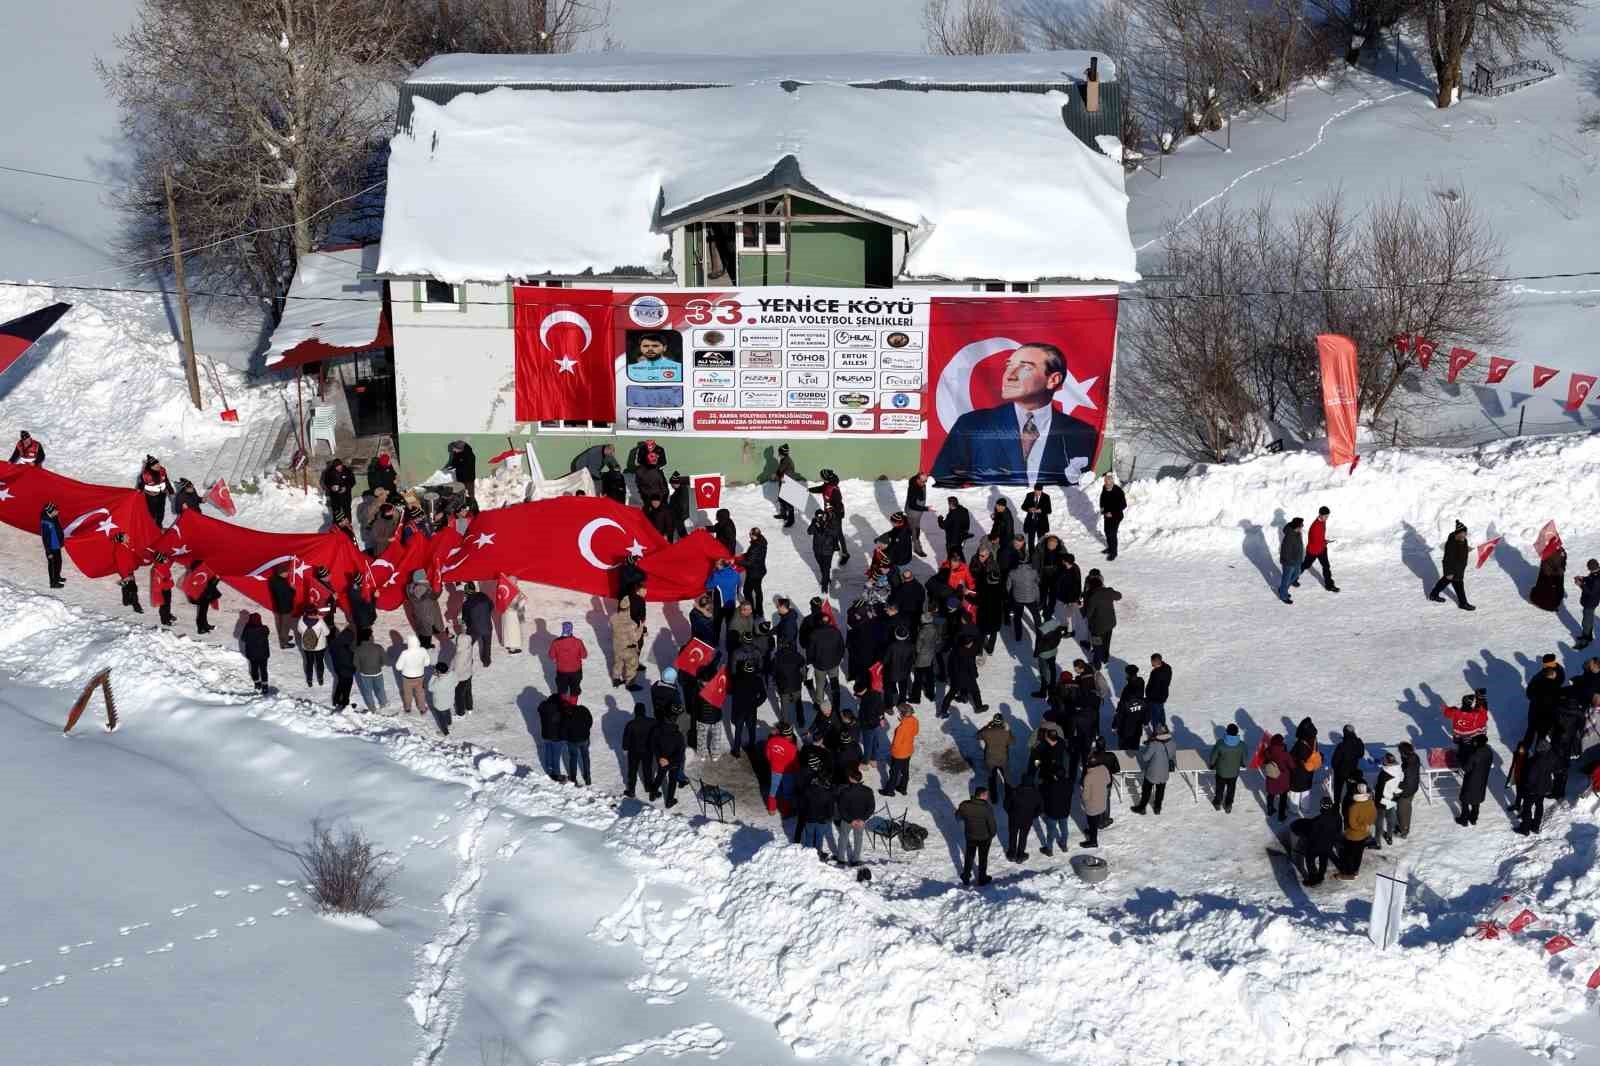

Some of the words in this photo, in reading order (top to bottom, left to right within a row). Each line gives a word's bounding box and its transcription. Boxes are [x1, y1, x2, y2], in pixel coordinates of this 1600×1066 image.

[758, 294, 839, 313] YENİCE
[848, 296, 913, 314] KÖYÜ
[760, 315, 796, 324] KARDA
[800, 315, 853, 325] VOLEYBOL
[856, 315, 913, 327] ŞENLİKLERİ
